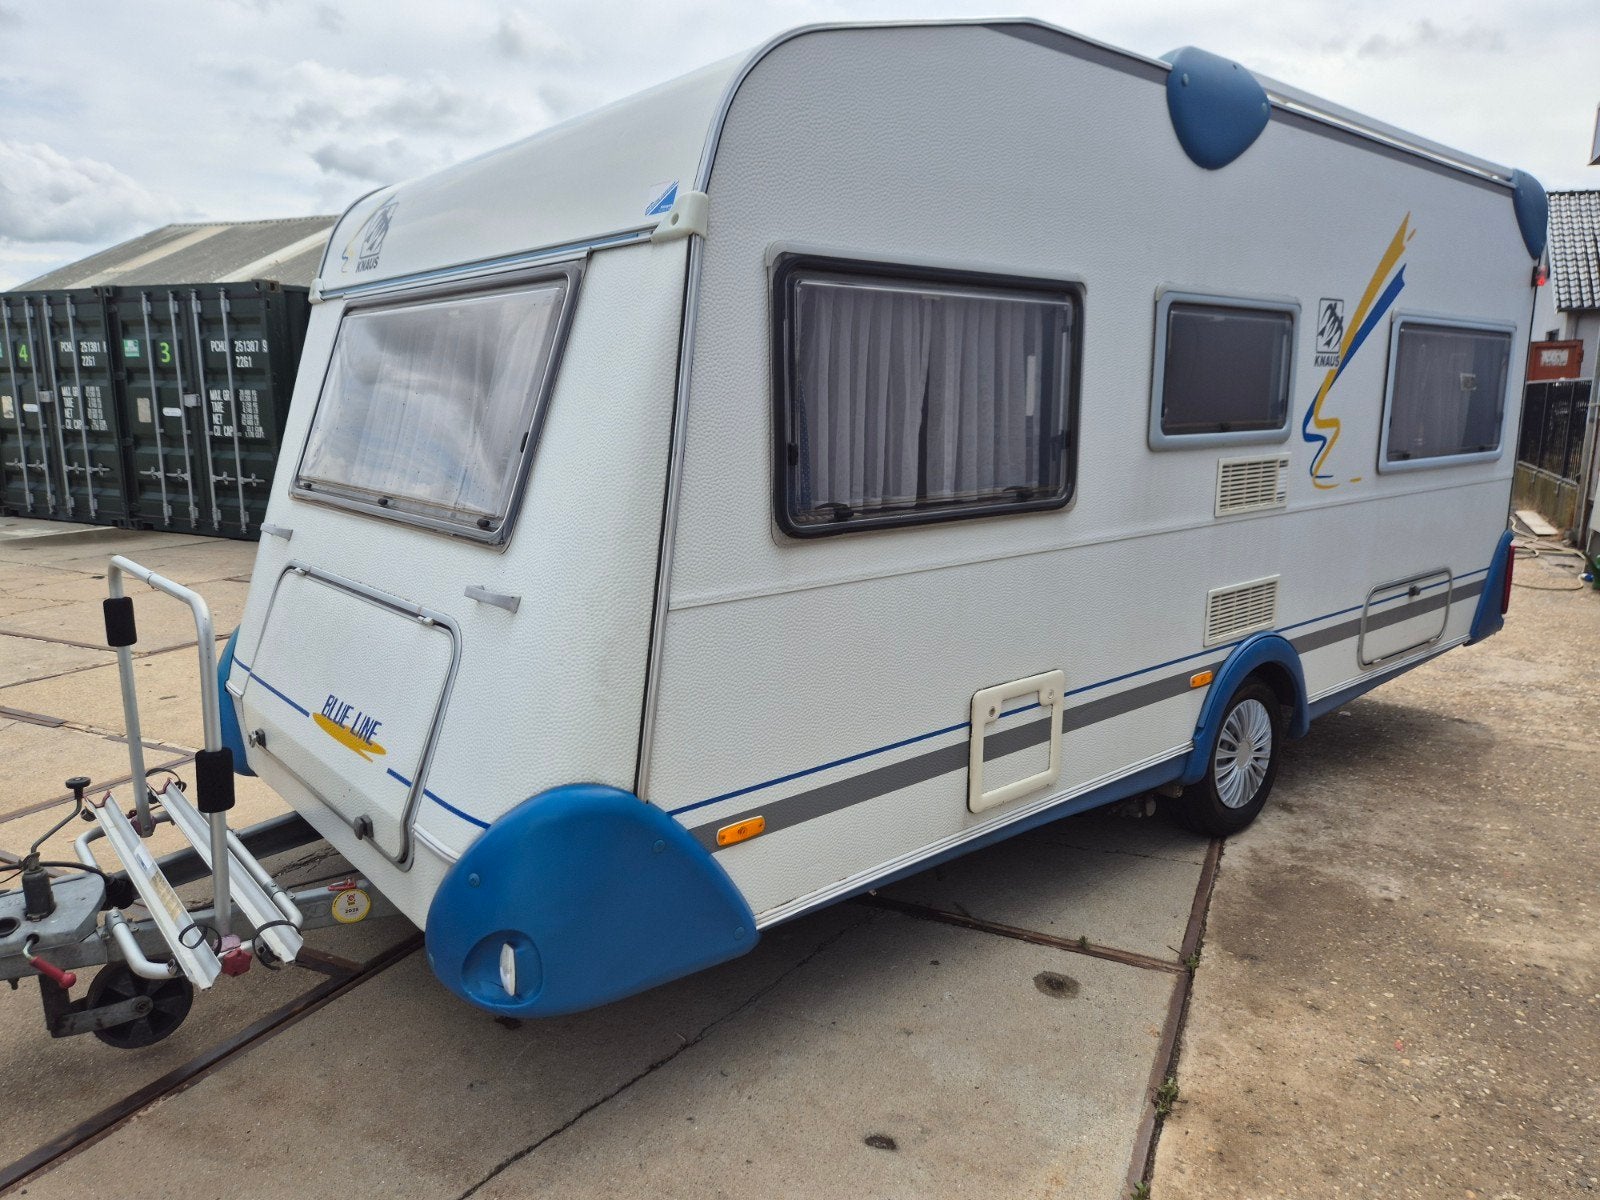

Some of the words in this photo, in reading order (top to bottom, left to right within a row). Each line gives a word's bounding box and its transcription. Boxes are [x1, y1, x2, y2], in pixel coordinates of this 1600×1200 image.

[355, 256, 380, 273] KNAUS
[19, 344, 29, 362] 4
[160, 341, 171, 363] 3
[1314, 354, 1340, 367] KNAUS
[321, 694, 355, 729] BLUE
[350, 711, 383, 746] LINE
